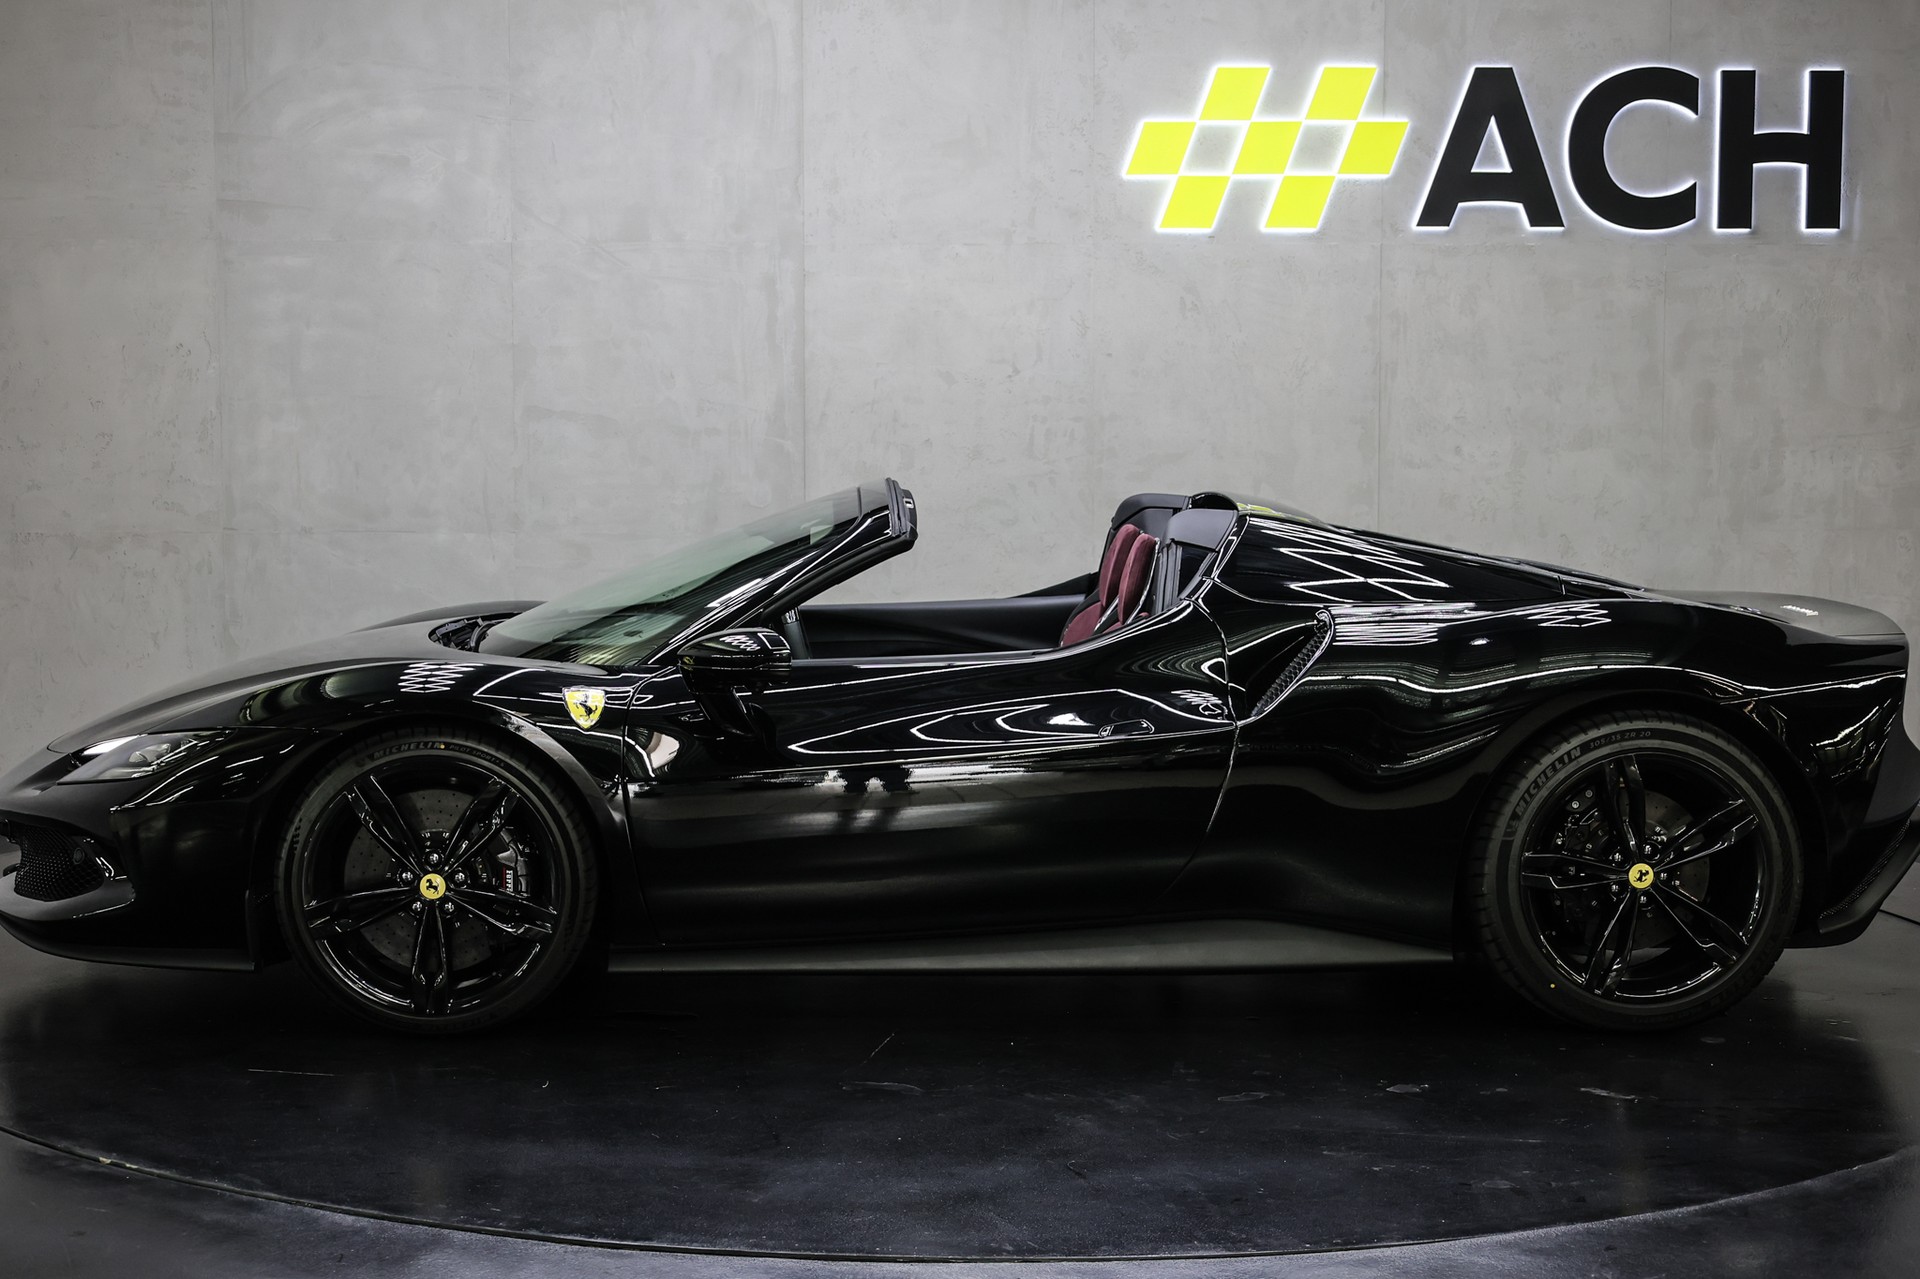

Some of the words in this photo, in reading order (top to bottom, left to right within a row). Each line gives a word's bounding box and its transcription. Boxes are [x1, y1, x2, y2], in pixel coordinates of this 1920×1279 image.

[1415, 67, 1843, 229] ACH
[1514, 746, 1581, 817] MICHELIN
[1639, 730, 1651, 738] 20
